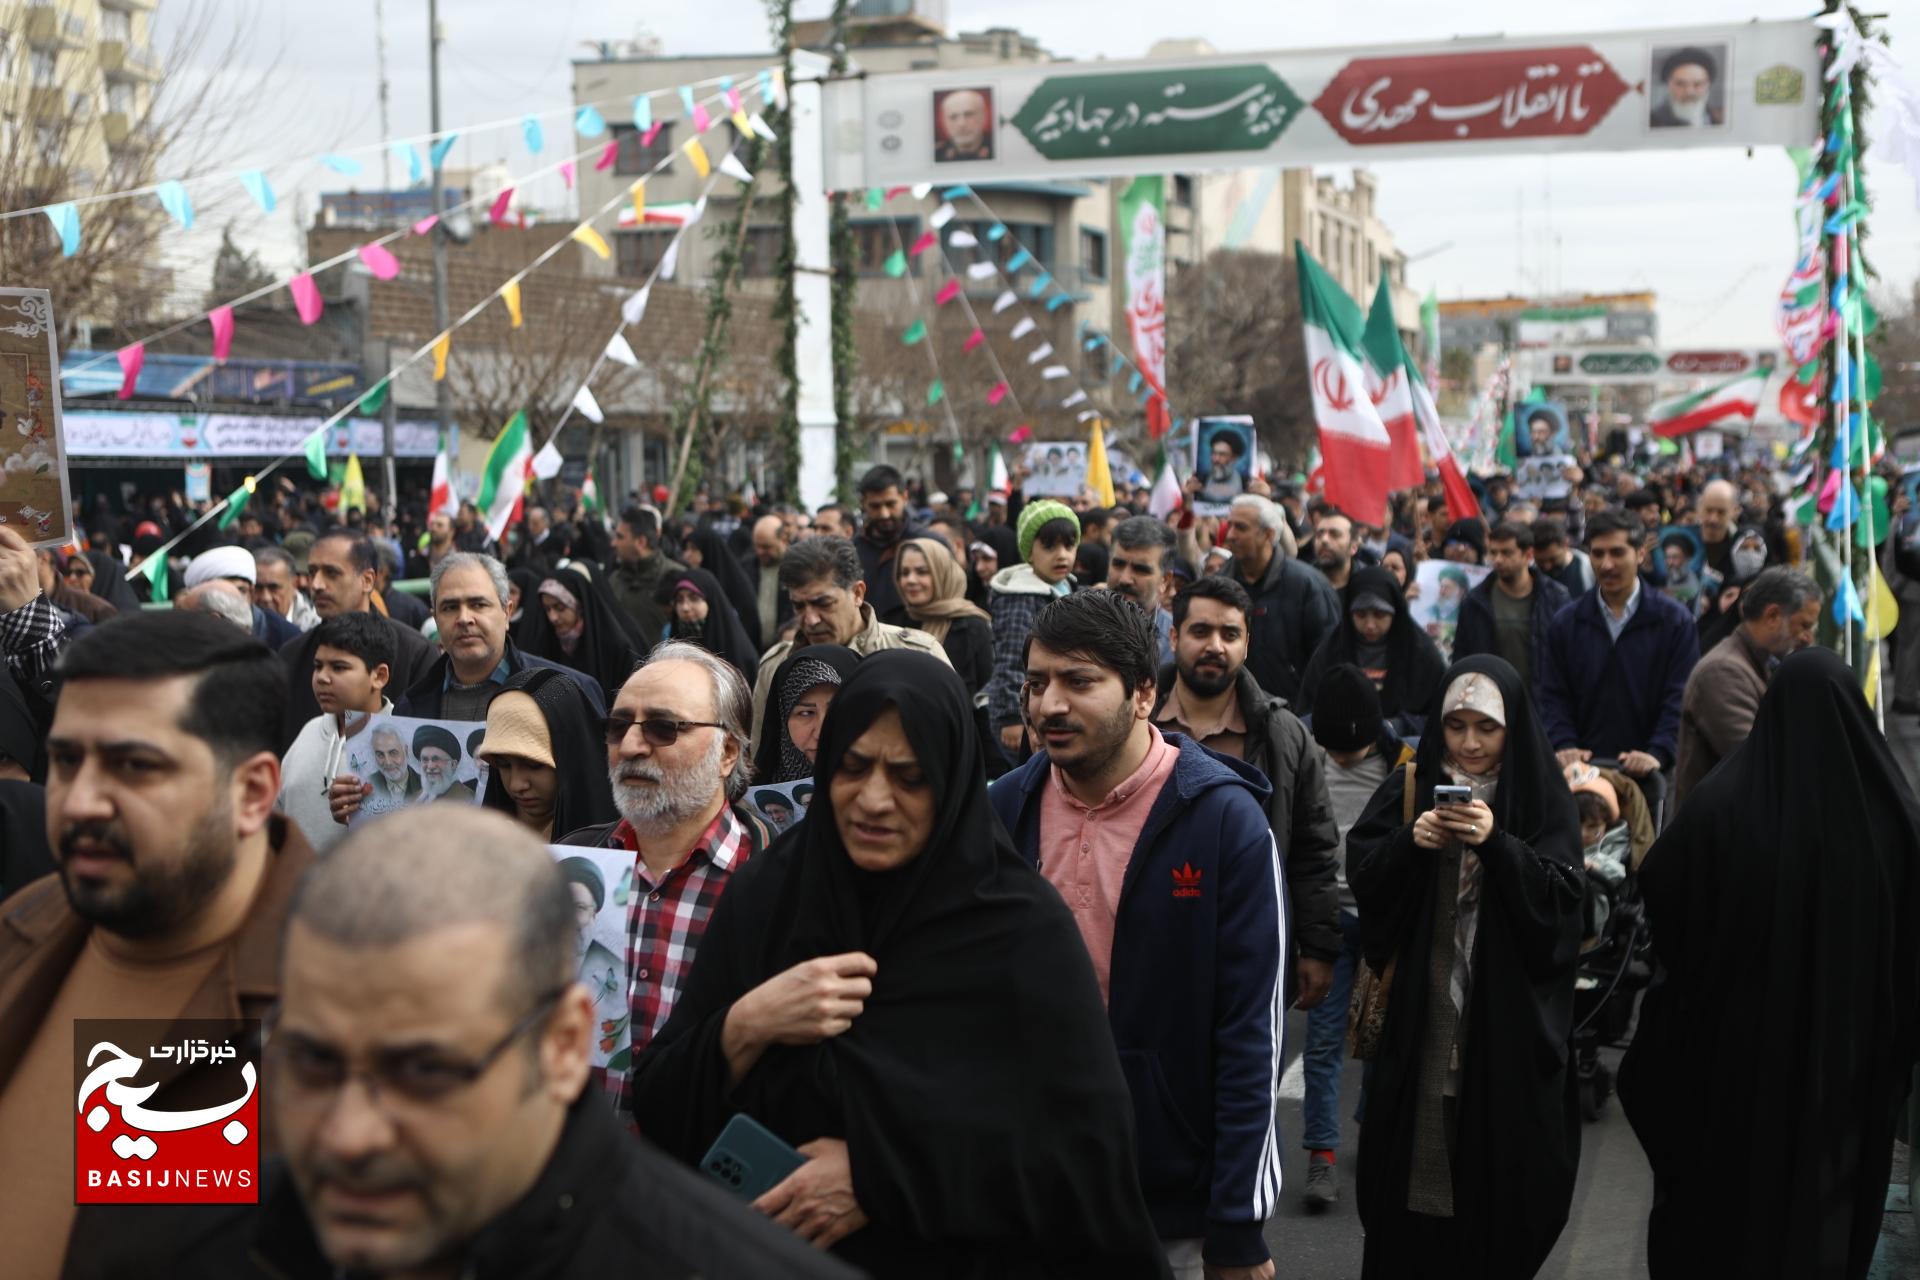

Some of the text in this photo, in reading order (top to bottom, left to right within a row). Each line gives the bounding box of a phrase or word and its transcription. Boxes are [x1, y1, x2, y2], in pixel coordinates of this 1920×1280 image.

[1030, 80, 1288, 148] پیوسته در جهادیم
[1429, 62, 1572, 138] انقلاب
[1569, 60, 1604, 123] تا
